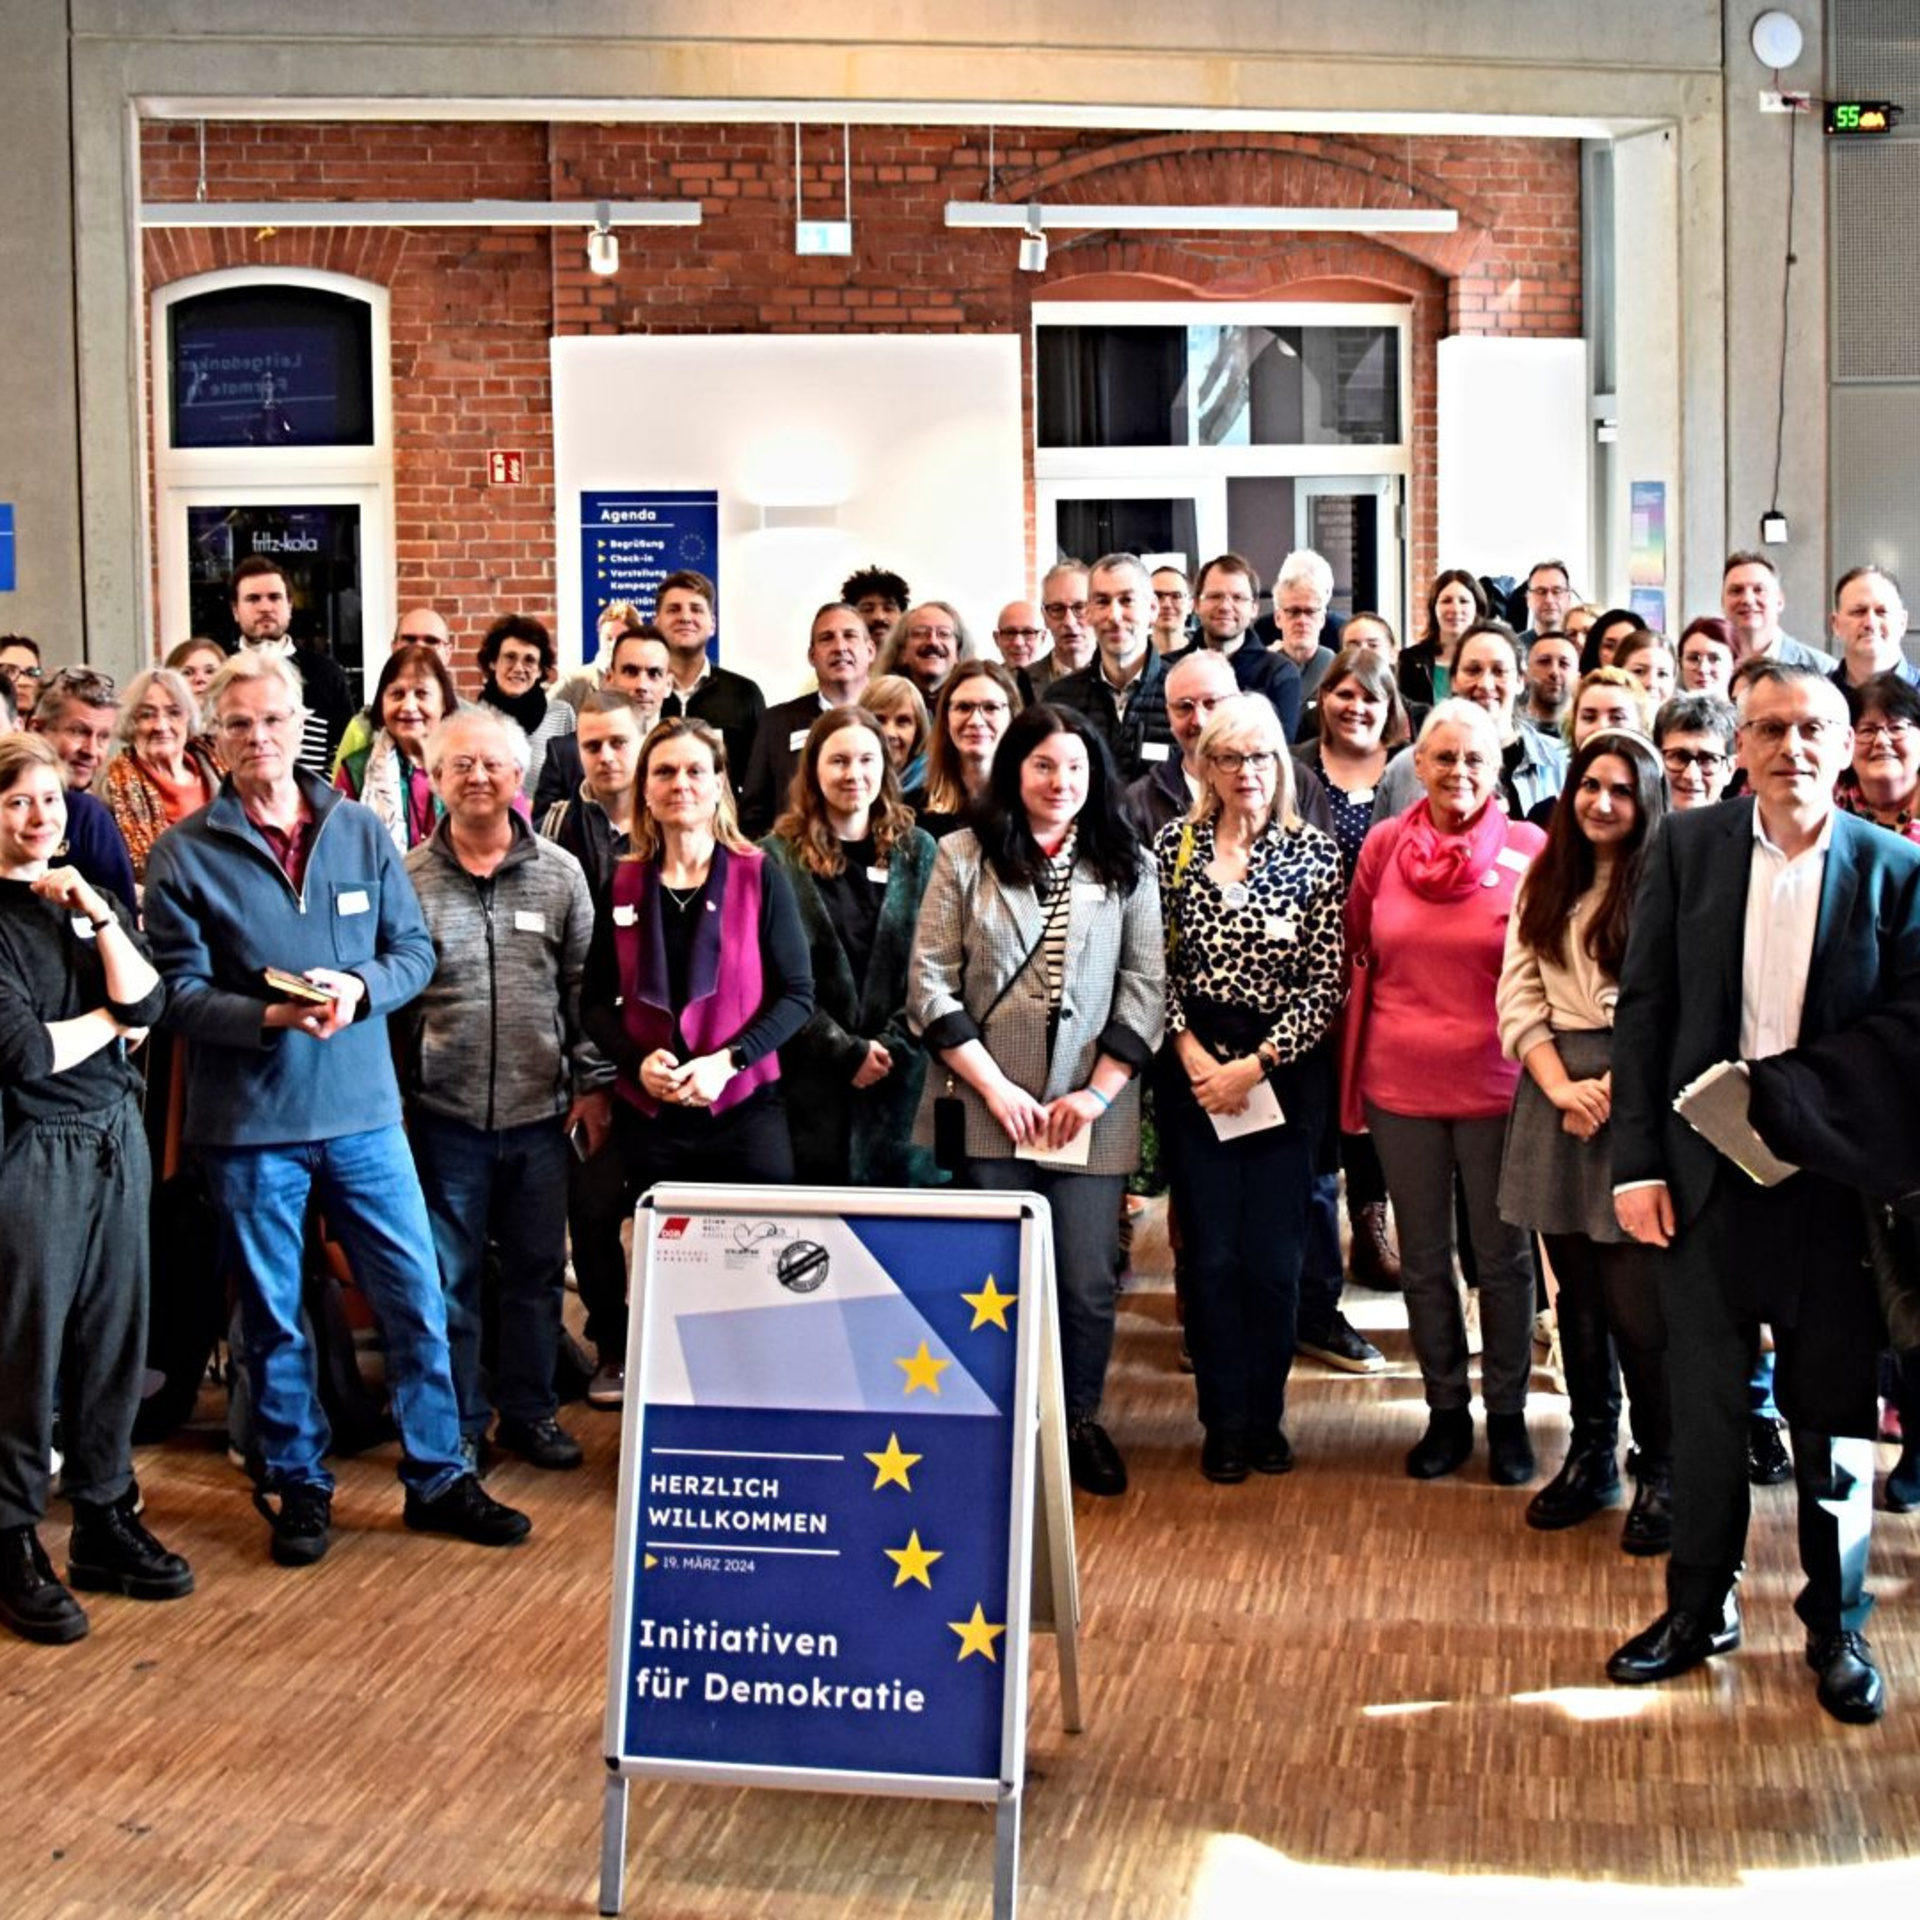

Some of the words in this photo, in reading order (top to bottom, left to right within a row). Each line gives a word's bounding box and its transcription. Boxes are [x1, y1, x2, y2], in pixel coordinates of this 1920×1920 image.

[601, 509, 657, 523] Agenda
[252, 530, 318, 552] fritz-kola
[610, 539, 665, 550] Begrüßung
[610, 553, 654, 563] Check-in
[610, 568, 667, 579] Vorstellung
[610, 582, 660, 592] Kampagn
[650, 1474, 779, 1498] HERZLICH
[648, 1506, 827, 1533] WILLKOMMEN
[663, 1556, 680, 1569] 19.
[683, 1555, 721, 1571] MÄRZ
[724, 1558, 755, 1572] 2024
[640, 1618, 838, 1657] Initiativen
[636, 1667, 689, 1699] für
[704, 1672, 925, 1712] Demokratie
